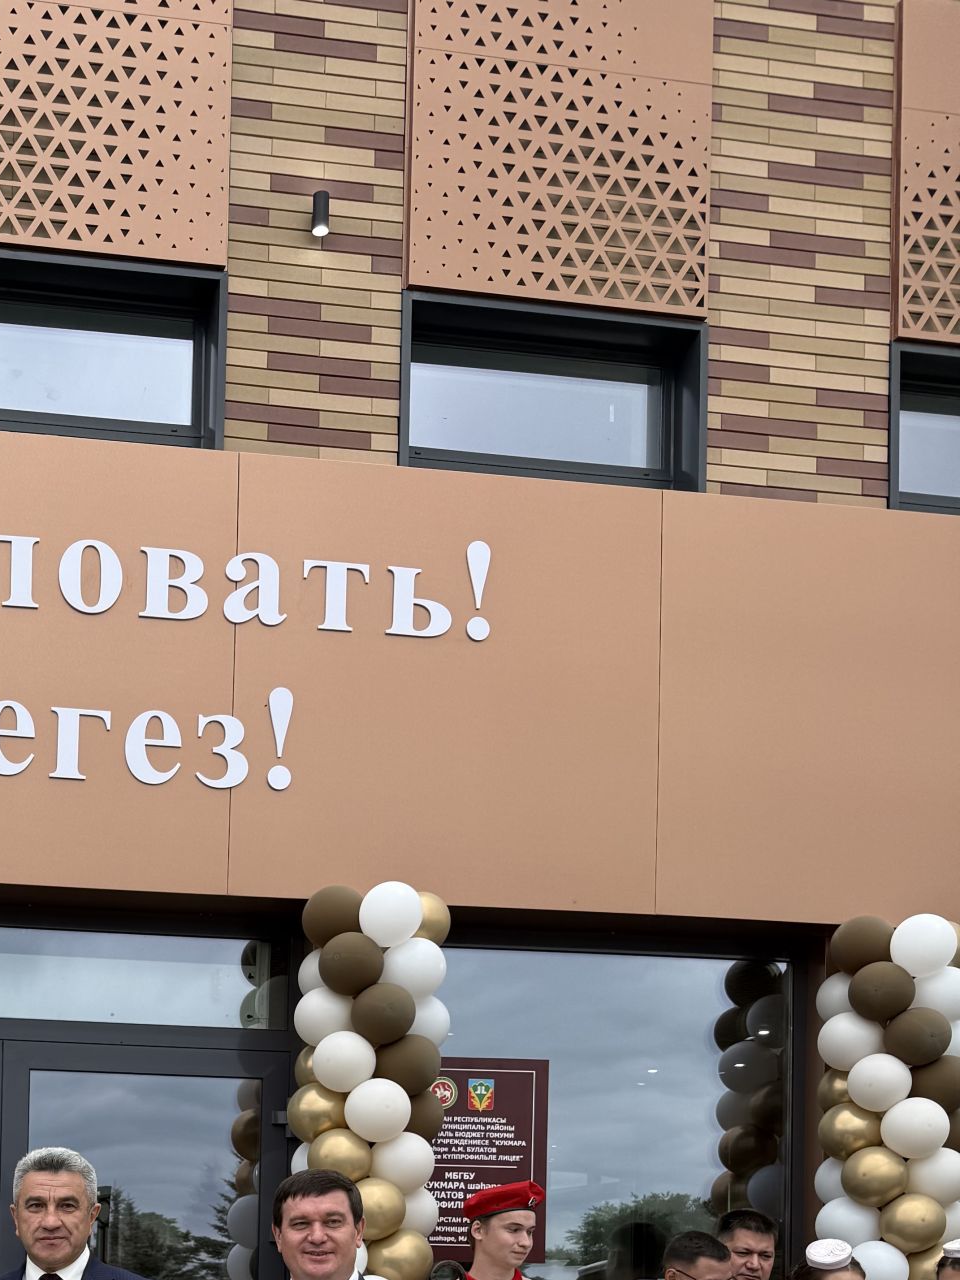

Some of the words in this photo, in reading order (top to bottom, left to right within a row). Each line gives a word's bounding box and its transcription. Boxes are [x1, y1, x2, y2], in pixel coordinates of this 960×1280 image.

[453, 1116, 507, 1124] РЕСПУБЛИКАСЫ
[486, 1123, 515, 1131] РАЙОНЫ
[455, 1131, 484, 1139] БЮДЖЕТ
[437, 1138, 490, 1146] УЧРЕЖДЕНИЕСЕ
[444, 1171, 476, 1180] МБГБУ
